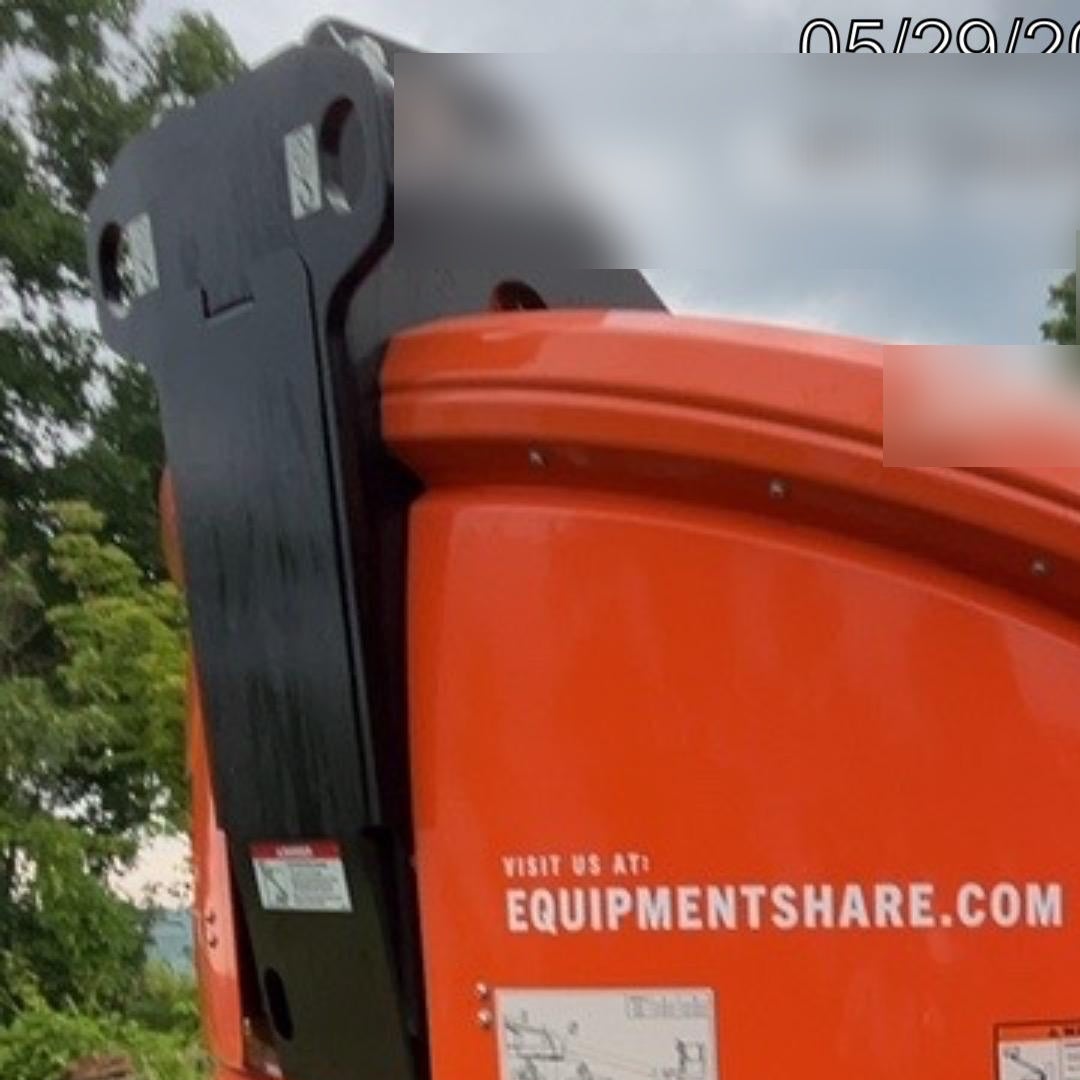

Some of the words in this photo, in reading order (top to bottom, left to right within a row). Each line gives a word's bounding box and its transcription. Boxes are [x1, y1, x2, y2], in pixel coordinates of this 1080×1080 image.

[502, 854, 561, 878] VISIT
[571, 853, 602, 877] US
[505, 883, 1065, 936] EQUIPMENTSHARE.COM
